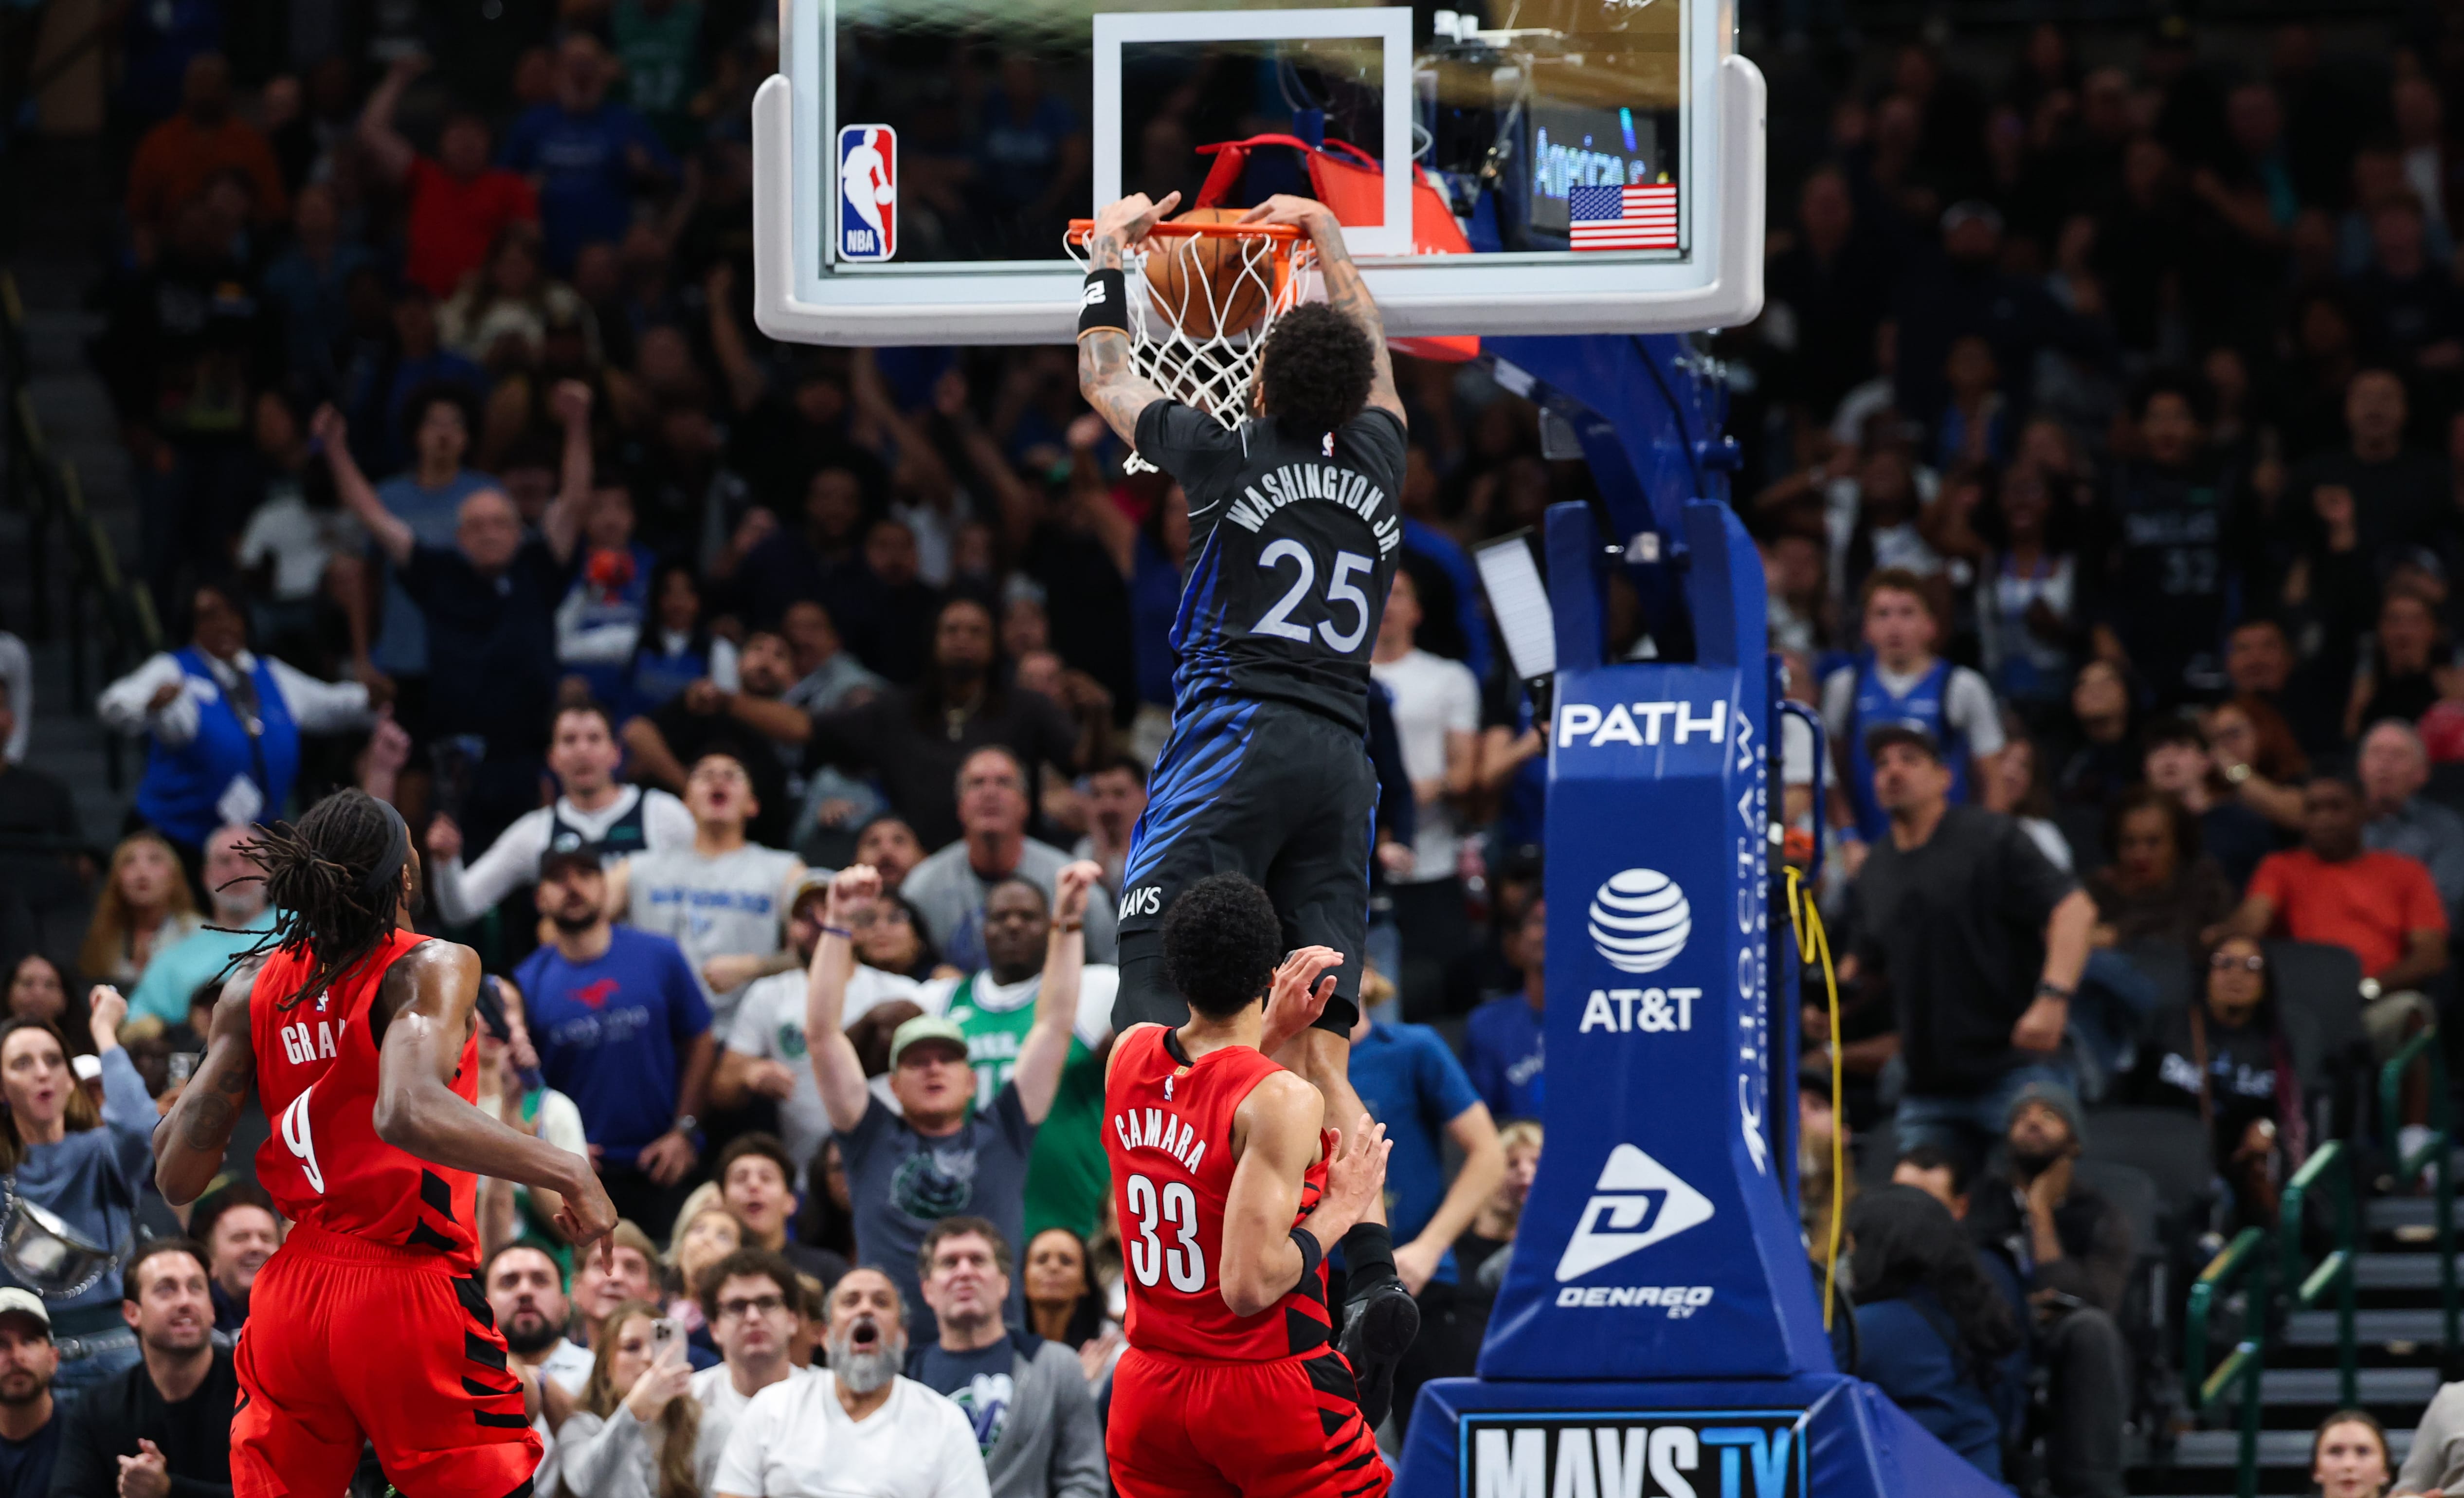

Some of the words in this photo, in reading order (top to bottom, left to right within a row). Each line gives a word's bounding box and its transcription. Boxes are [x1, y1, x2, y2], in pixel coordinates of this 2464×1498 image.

[847, 229, 875, 253] NBA
[1225, 463, 1385, 533] WASHINGTON
[1249, 538, 1375, 653] 25
[1558, 699, 1727, 748] PATH
[1737, 710, 1761, 1130] CHOCTAW
[1578, 986, 1703, 1034] AT&T
[281, 1085, 326, 1195] 9
[1114, 1107, 1207, 1175] CAMARA
[1126, 1172, 1207, 1294] 33
[1555, 1286, 1715, 1308] DENAGO
